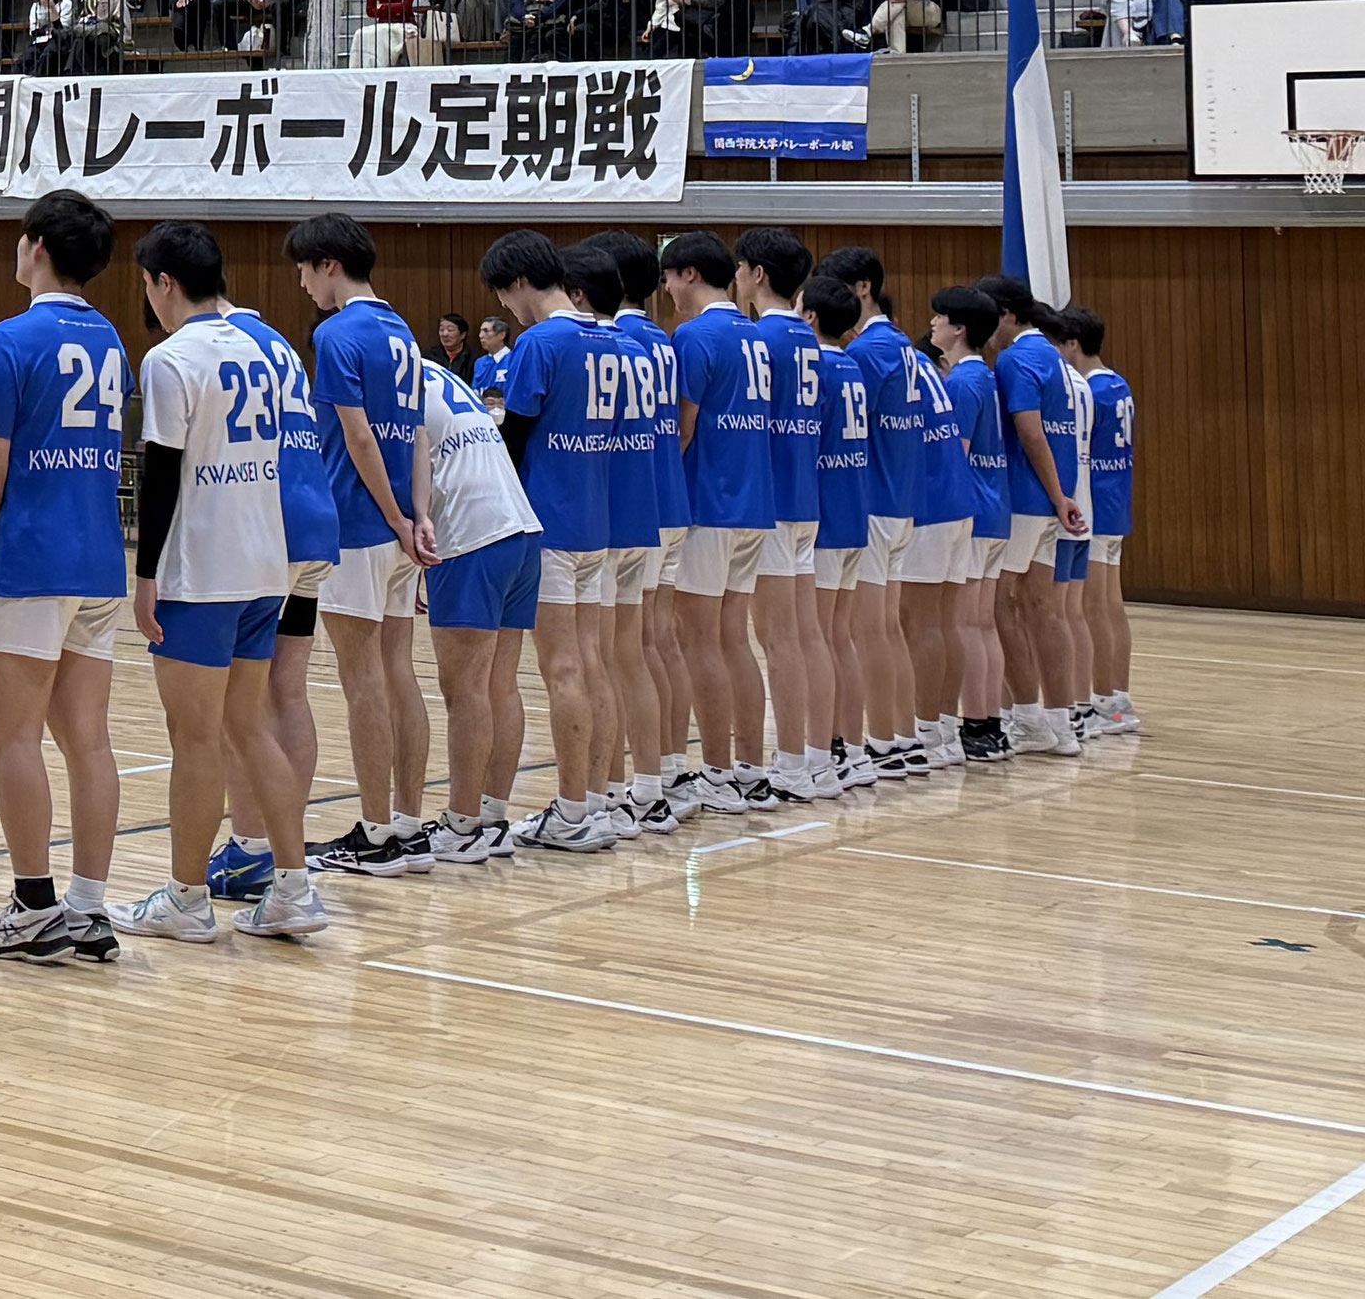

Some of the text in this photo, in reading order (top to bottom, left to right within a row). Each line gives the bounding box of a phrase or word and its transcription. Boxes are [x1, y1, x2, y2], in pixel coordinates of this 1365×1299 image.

[57, 343, 123, 431] 24
[389, 335, 421, 410] 21
[585, 352, 619, 420] 19
[621, 355, 655, 419] 18
[652, 342, 677, 405] 17
[741, 339, 771, 401] 16
[794, 346, 819, 406] 15
[900, 346, 921, 403] 12
[919, 362, 953, 414] 11
[219, 361, 279, 443] 23
[841, 382, 868, 440] 13
[1115, 396, 1135, 448] 30
